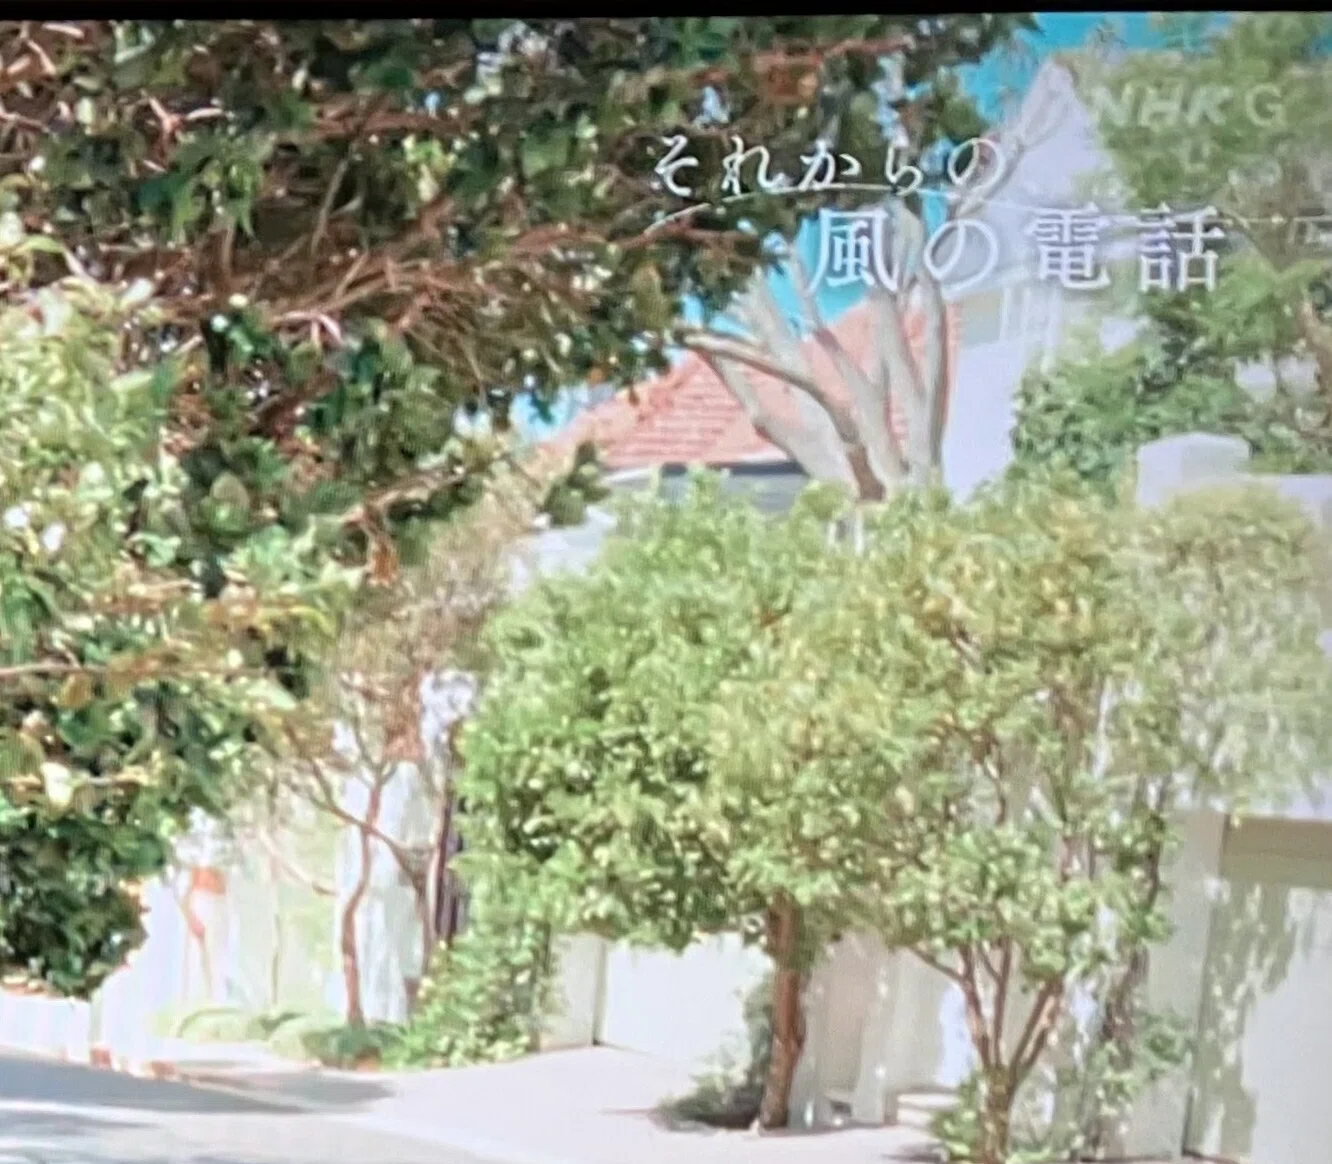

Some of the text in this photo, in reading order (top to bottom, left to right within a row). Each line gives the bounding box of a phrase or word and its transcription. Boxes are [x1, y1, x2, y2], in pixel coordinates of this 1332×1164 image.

[1090, 82, 1286, 127] NHK G
[653, 134, 1004, 196] それからの
[812, 204, 1225, 293] 風の電話
